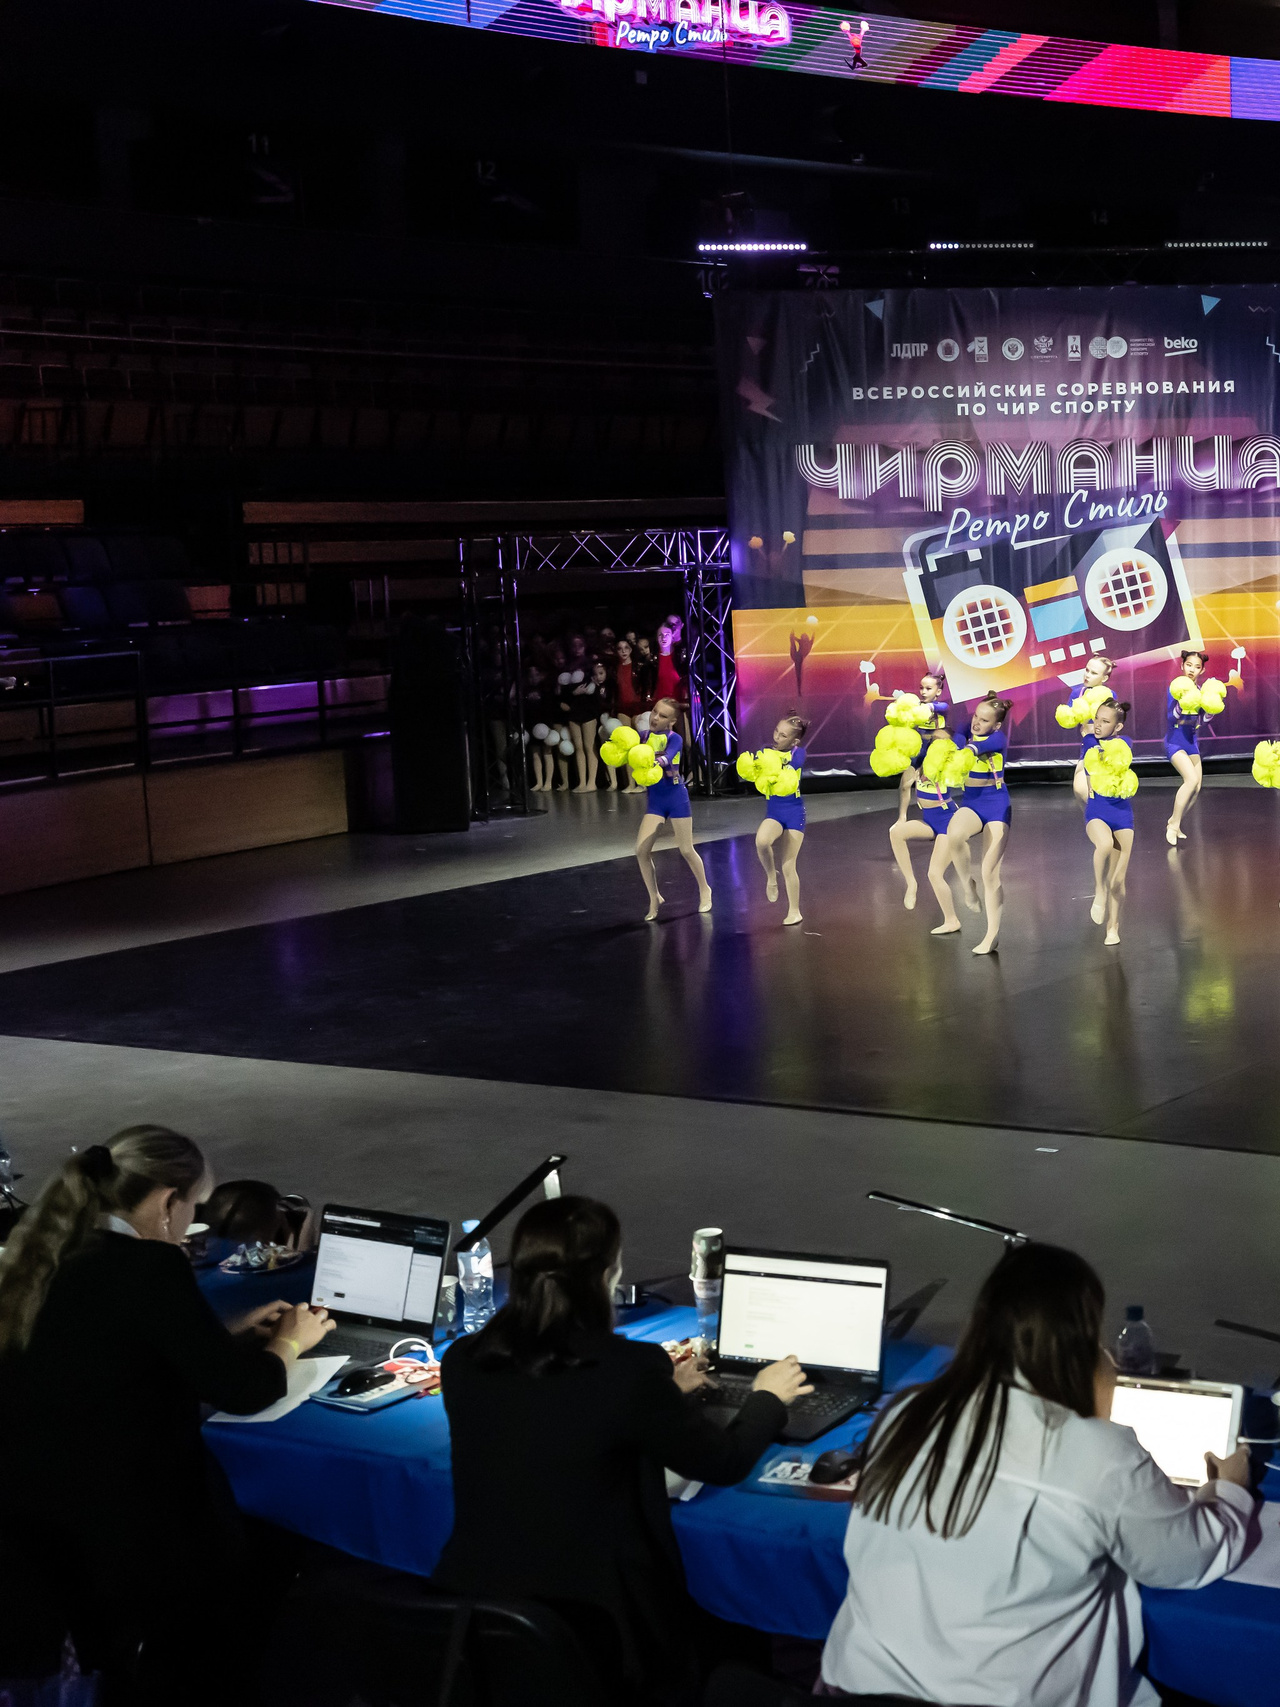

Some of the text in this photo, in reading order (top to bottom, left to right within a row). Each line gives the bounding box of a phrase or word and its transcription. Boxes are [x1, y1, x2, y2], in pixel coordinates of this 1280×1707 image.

[616, 21, 728, 50] Ретро Стиль
[891, 343, 928, 359] ЛДПР
[1164, 337, 1198, 349] beko
[852, 380, 1236, 400] ВСЕРОССИЙСКИЕ СОРЕВНОВАНИЯ
[957, 400, 1136, 416] ПО ЧИР СПОРТУ
[944, 489, 1168, 549] Ретро Стиль
